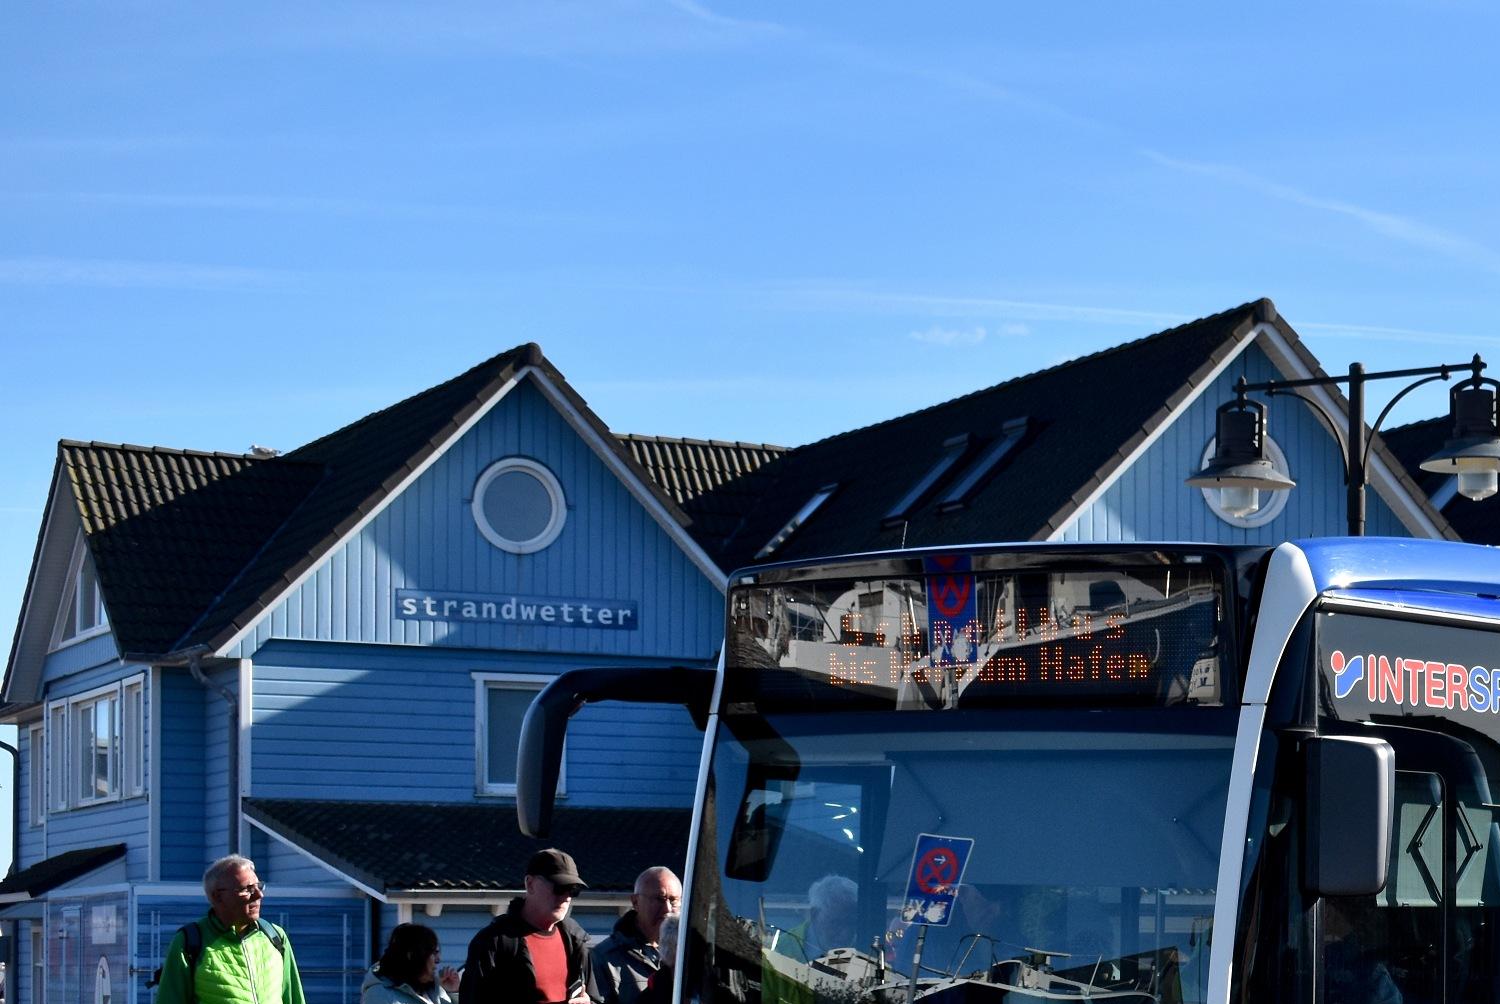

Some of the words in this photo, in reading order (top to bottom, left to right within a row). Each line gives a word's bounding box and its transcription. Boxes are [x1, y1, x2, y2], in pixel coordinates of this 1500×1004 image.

[402, 597, 632, 625] strandwetter
[829, 651, 876, 685] bis
[1040, 645, 1148, 681] Hafen
